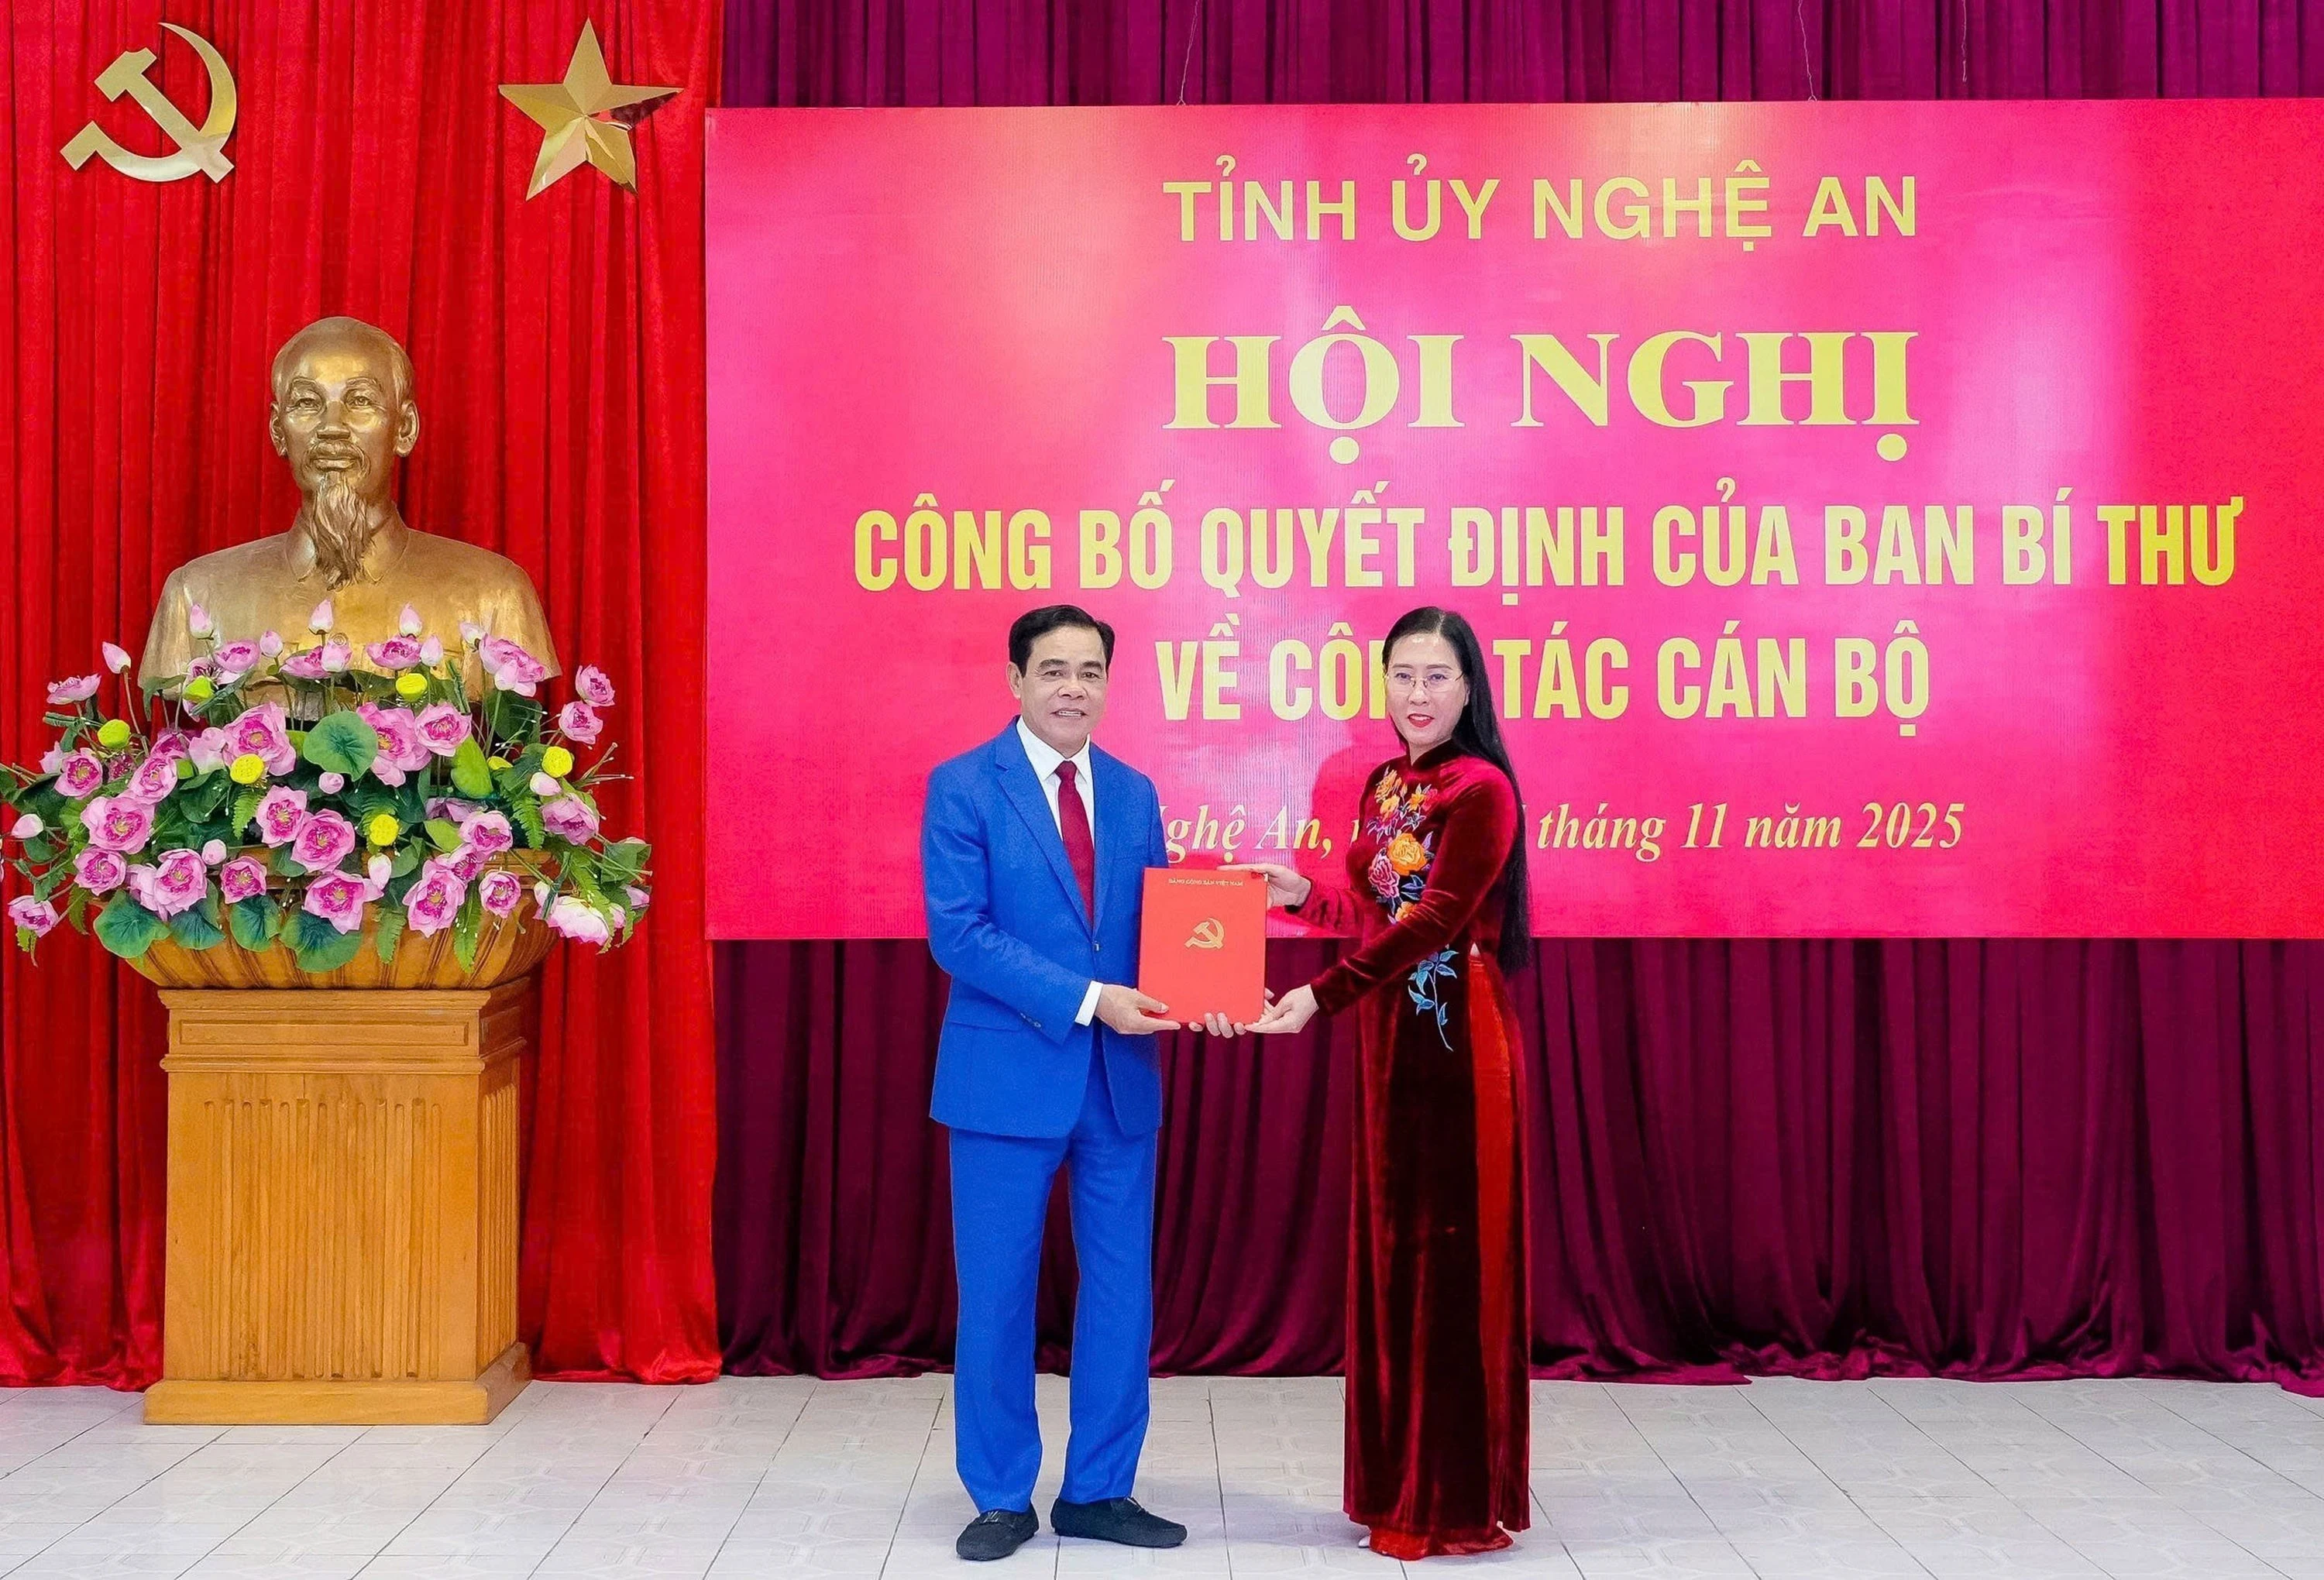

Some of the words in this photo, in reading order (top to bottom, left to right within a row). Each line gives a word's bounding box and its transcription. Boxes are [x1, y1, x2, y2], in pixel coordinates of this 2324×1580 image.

[1162, 153, 1356, 242] TỈNH
[1391, 153, 1501, 242] ỦY
[1532, 159, 1773, 252] NGHỆ
[1802, 175, 1917, 238] AN
[1161, 304, 1466, 465] HỘI
[1509, 329, 1920, 462] NGHỊ
[854, 493, 1052, 592] CÔNG
[1078, 479, 1177, 590] BỐ
[1200, 480, 1425, 598] QUYẾT
[1448, 506, 1625, 606] ĐỊNH
[1652, 477, 1800, 587] CỦA
[1824, 504, 1975, 586] BAN
[2003, 487, 2073, 586] BÍ
[2096, 496, 2244, 586] THƯ
[1155, 613, 1241, 721] VỀ
[1492, 620, 1631, 720] TÁC
[1656, 620, 1807, 720] CÁN
[1835, 620, 1930, 737] BỘ
[1160, 804, 1246, 864] ghệ
[1252, 804, 1332, 859] An,
[1537, 802, 1667, 862] tháng
[1679, 802, 1729, 848] 11
[1745, 802, 1842, 849] năm
[1855, 802, 1965, 849] 2025
